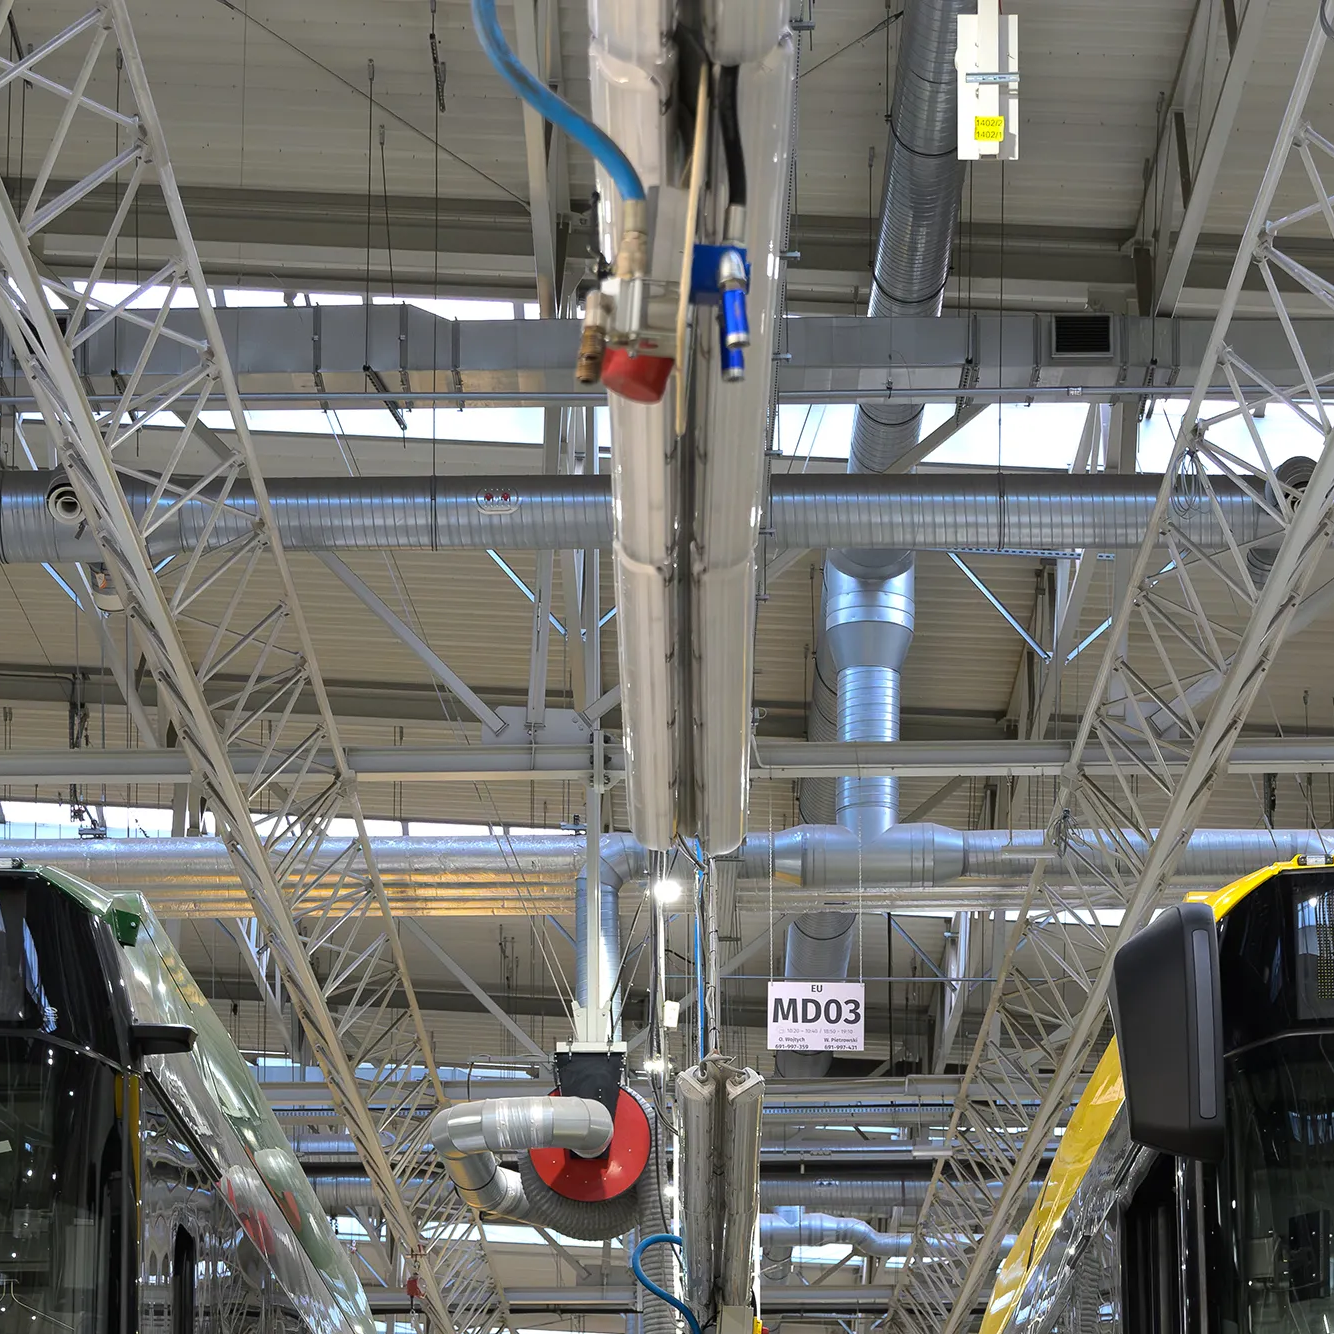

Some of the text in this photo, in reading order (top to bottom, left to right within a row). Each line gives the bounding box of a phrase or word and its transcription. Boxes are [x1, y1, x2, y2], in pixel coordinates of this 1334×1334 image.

[976, 119, 1003, 127] 1402/2
[976, 131, 1002, 139] 1402/1
[811, 984, 823, 993] EU
[772, 997, 861, 1025] MD03
